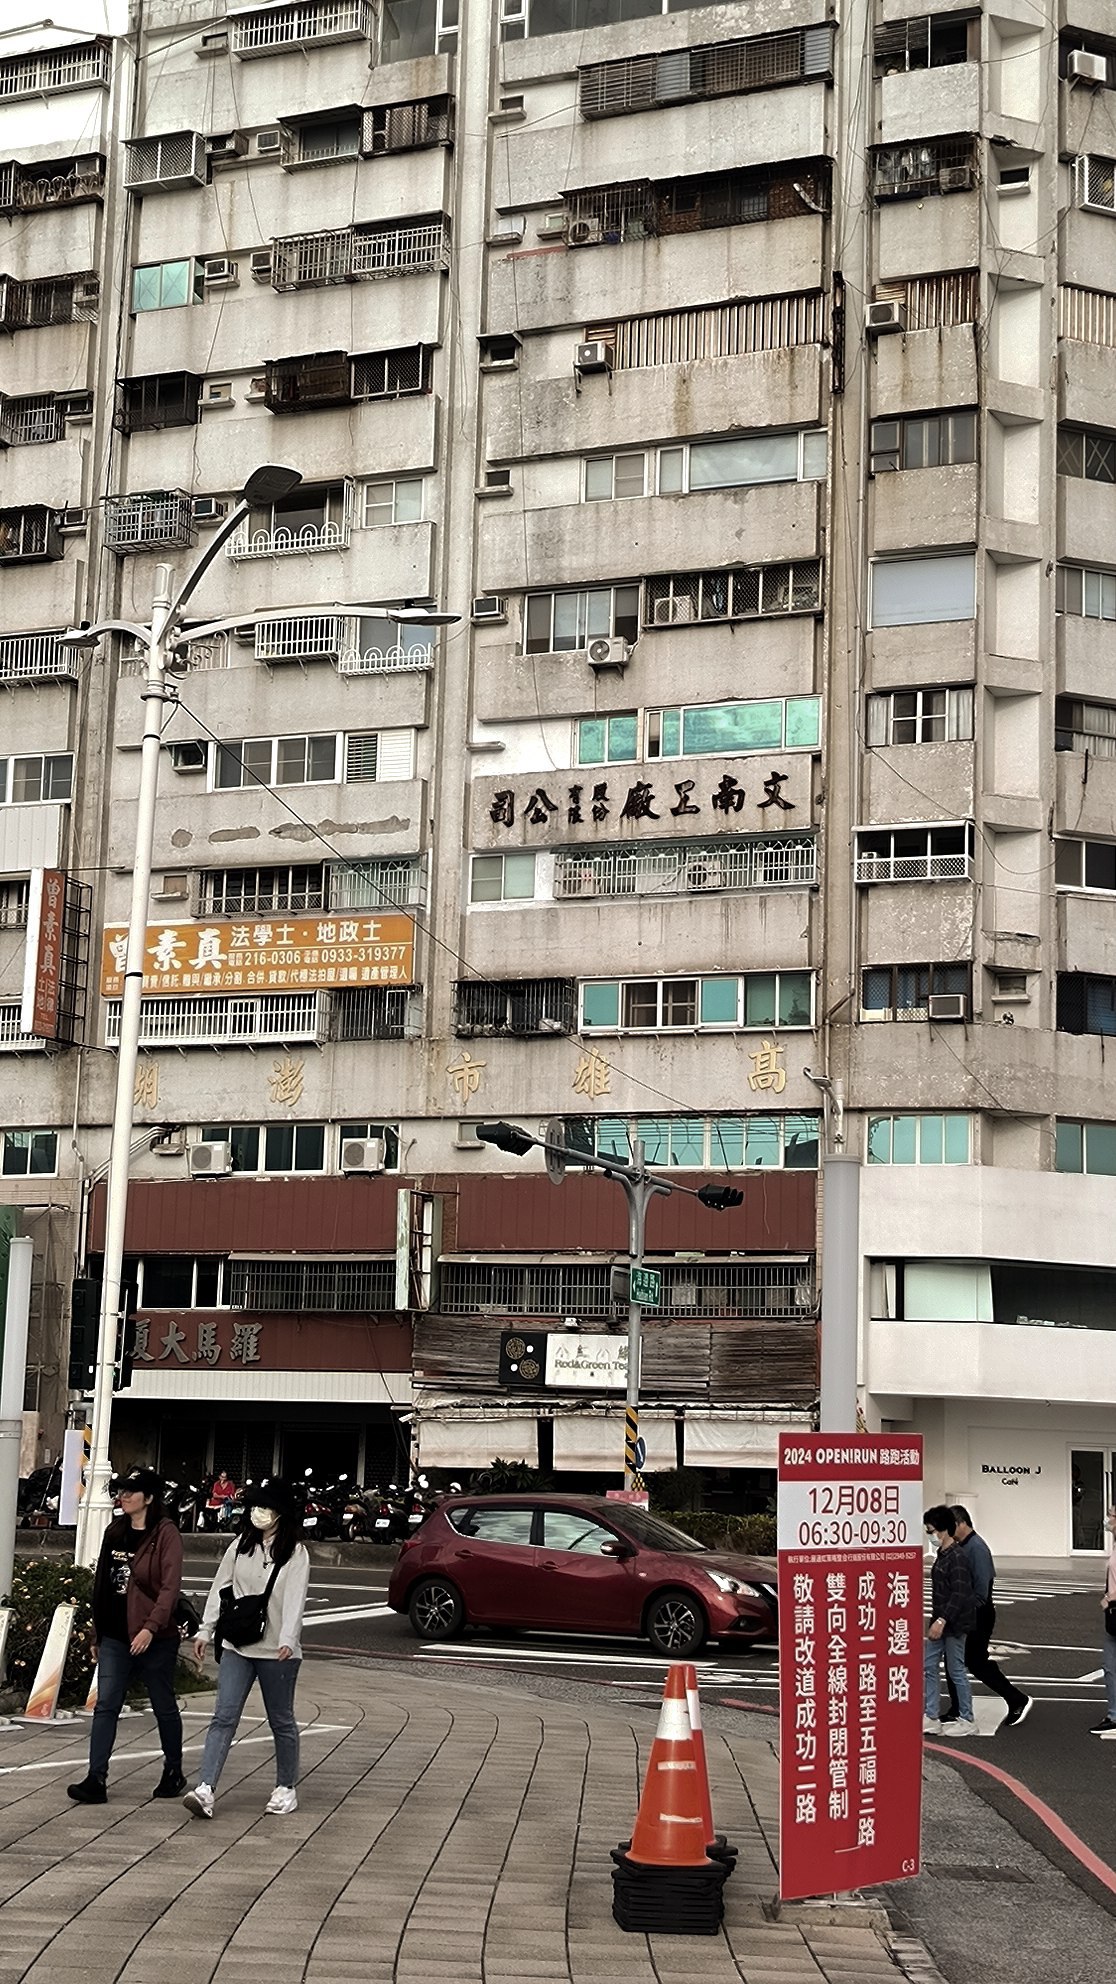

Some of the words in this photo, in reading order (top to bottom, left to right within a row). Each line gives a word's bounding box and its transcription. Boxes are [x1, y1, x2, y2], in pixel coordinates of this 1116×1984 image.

[244, 950, 301, 966] 216-0306
[321, 946, 406, 963] 0933-319377
[784, 1447, 812, 1465] 2024
[879, 1448, 919, 1466] 路跑活動
[981, 1464, 1031, 1475] BALLOON
[1034, 1466, 1042, 1475] J
[808, 1485, 900, 1516] 12月08日
[798, 1519, 907, 1546] 06:30-09:30
[887, 1571, 910, 1703] 海邊路
[792, 1573, 818, 1825] 敬請改道成功二路
[826, 1571, 849, 1822] 雙向全線封閉管制
[857, 1570, 877, 1847] 成功二路至五福三路
[902, 1858, 915, 1872] C-3
